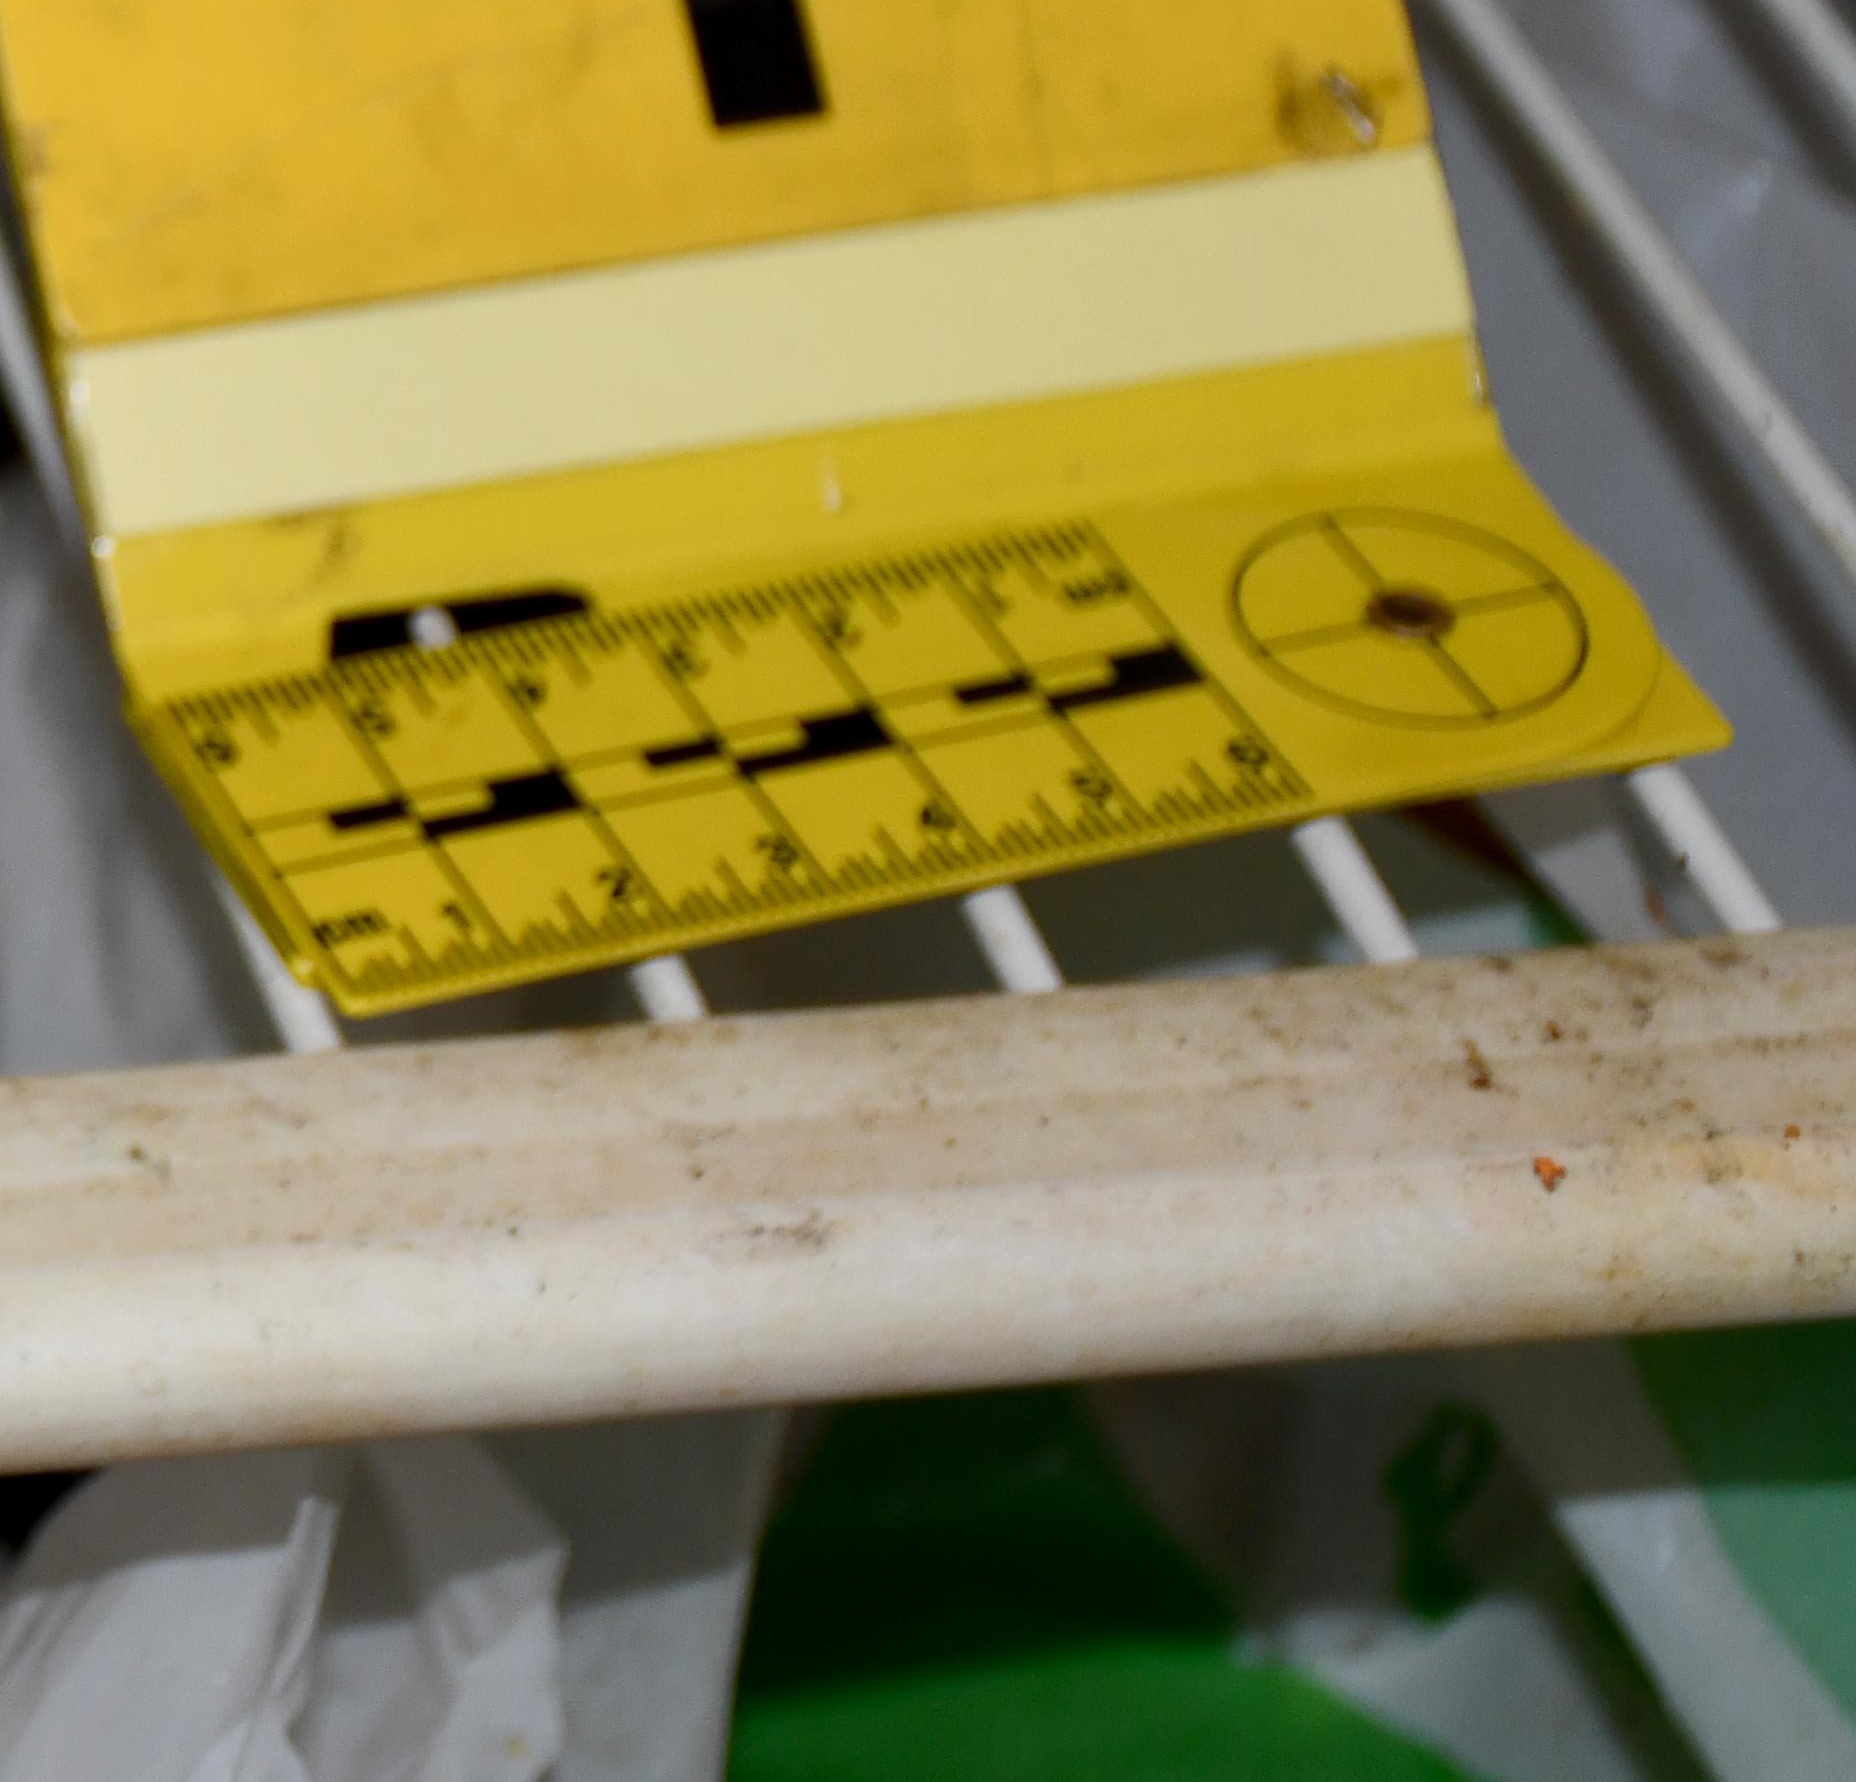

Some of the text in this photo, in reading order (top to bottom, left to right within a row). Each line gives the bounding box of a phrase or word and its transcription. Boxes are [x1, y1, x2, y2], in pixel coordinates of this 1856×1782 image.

[314, 910, 386, 948] cm
[440, 901, 473, 930] 1
[596, 866, 632, 901] 2
[754, 834, 798, 869] 3
[1069, 769, 1114, 807] 5
[1225, 737, 1270, 776] 6
